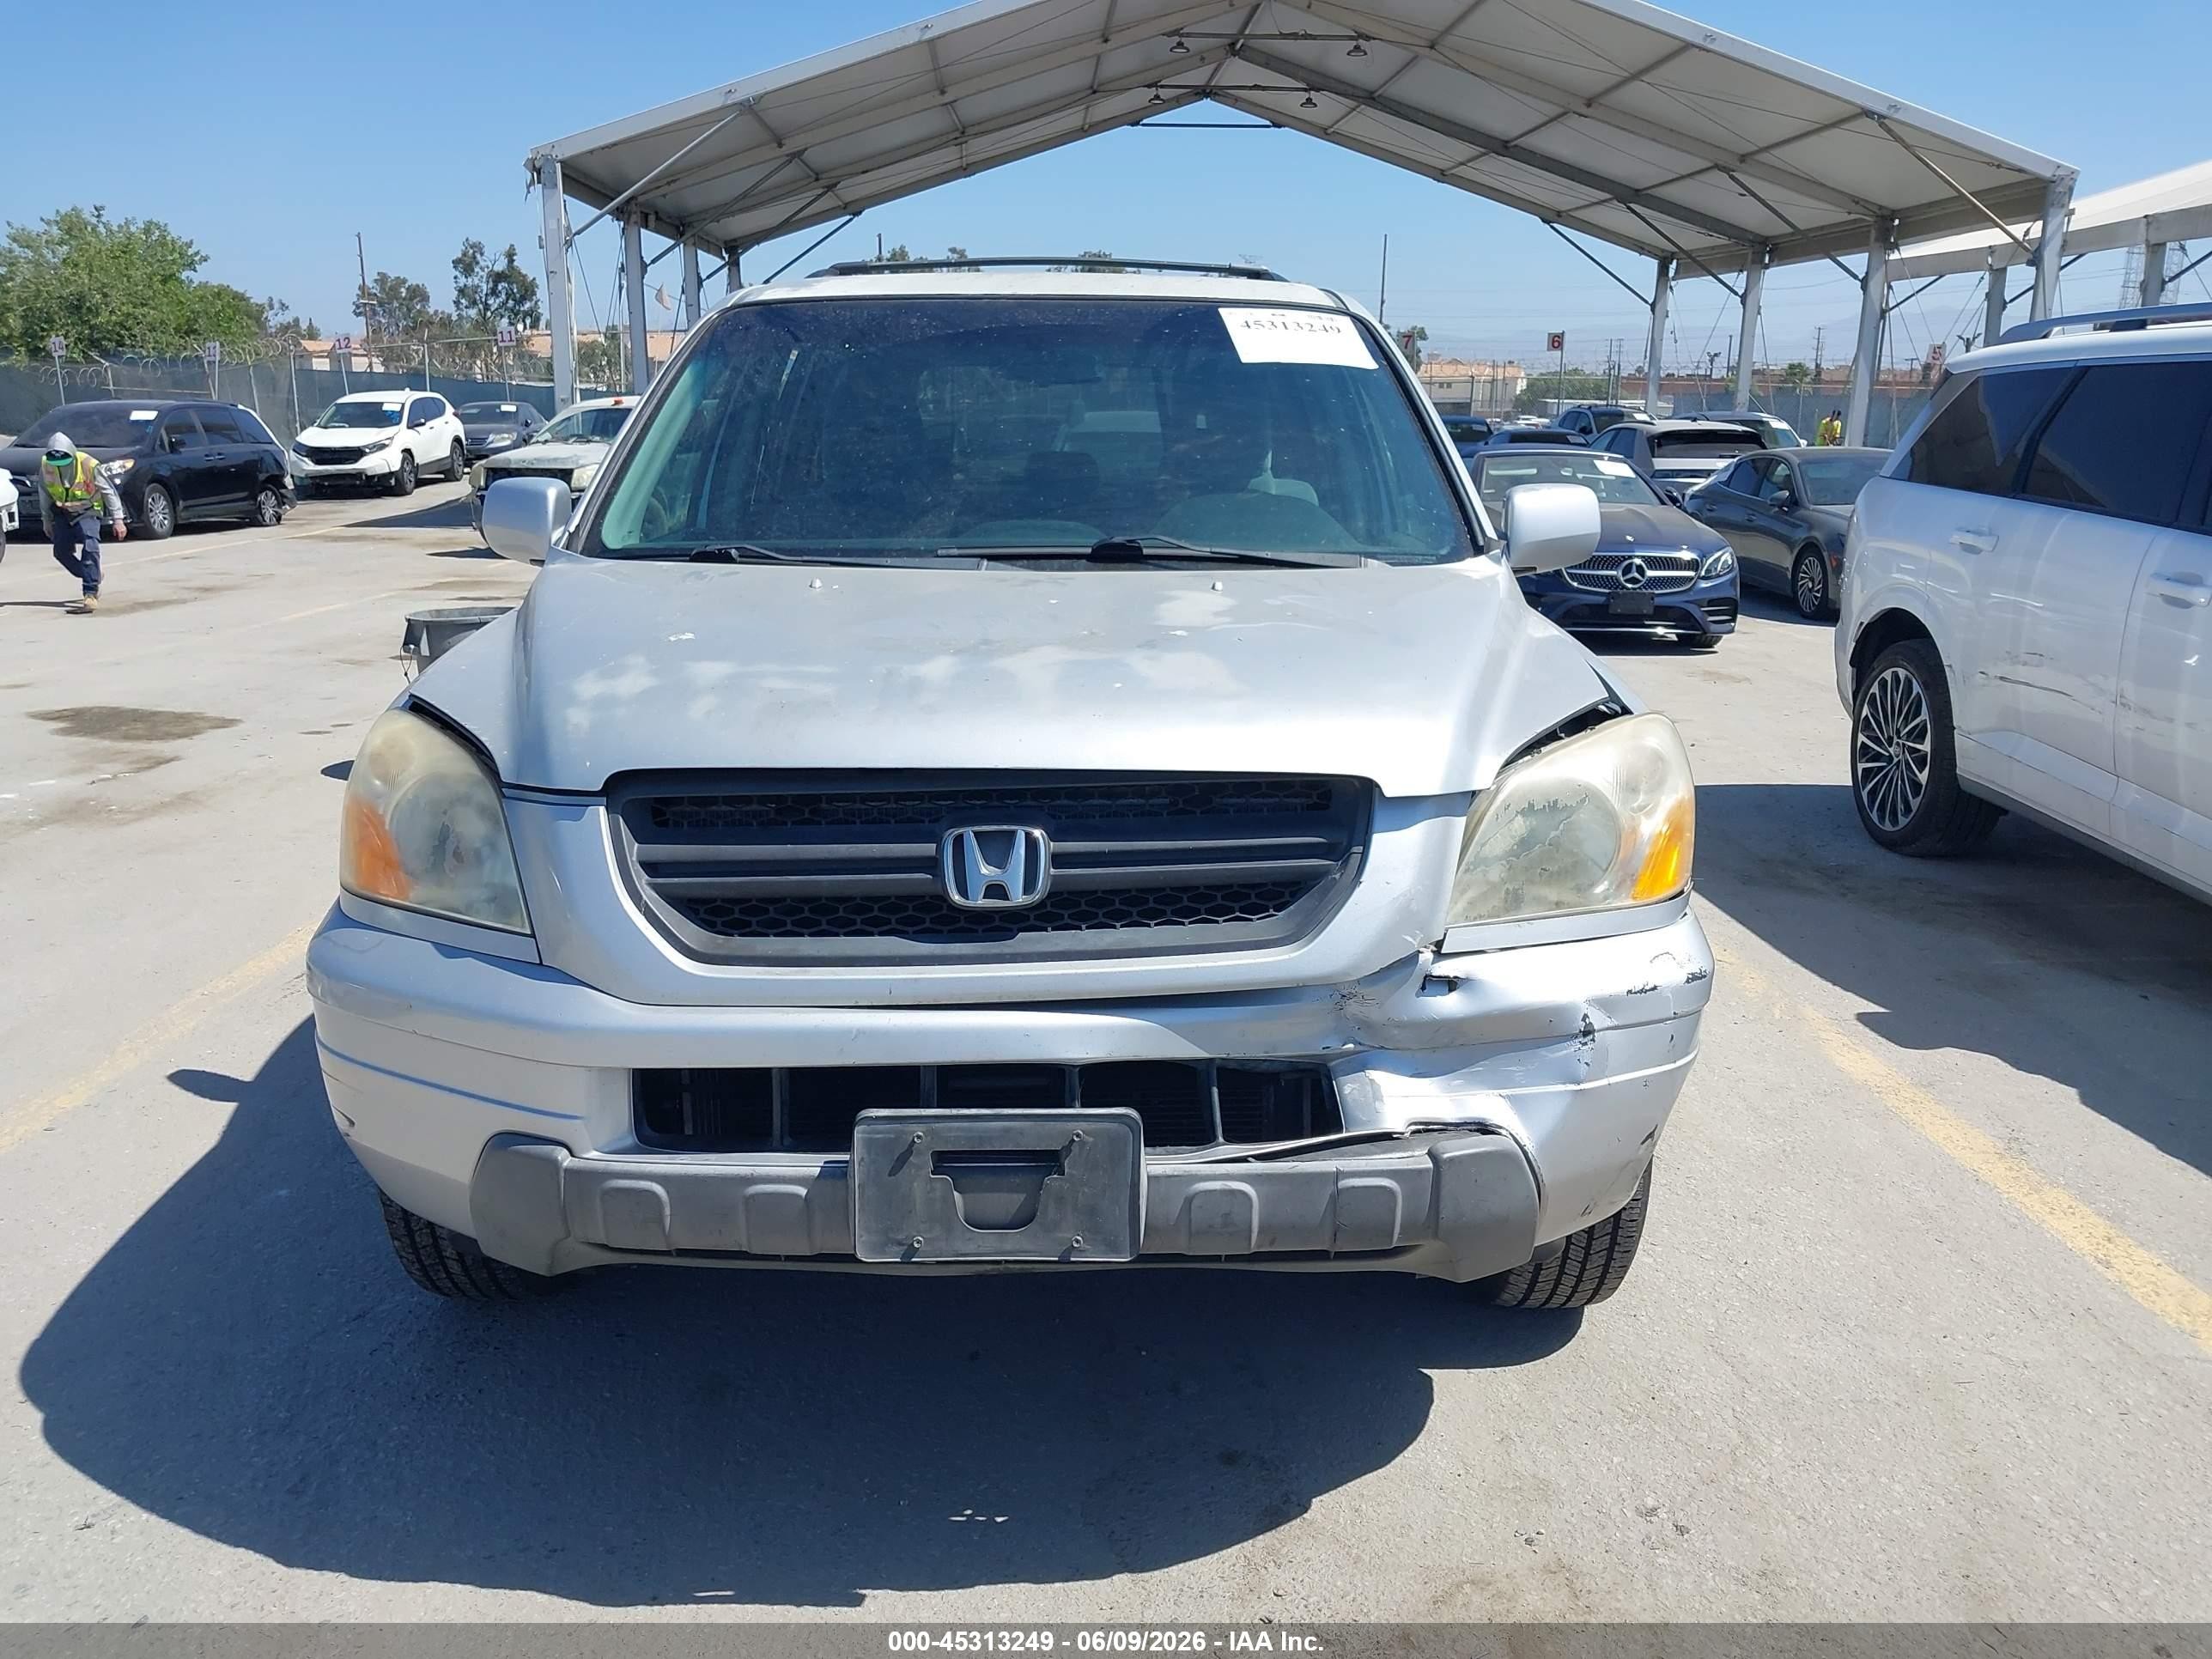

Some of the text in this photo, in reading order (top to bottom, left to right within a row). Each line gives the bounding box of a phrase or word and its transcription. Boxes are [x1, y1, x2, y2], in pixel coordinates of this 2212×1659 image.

[499, 330, 514, 343] 11
[1402, 335, 1413, 349] 7
[1552, 335, 1561, 349] 6
[52, 341, 64, 353] 14
[336, 337, 351, 350] 12
[1931, 346, 1942, 361] 5
